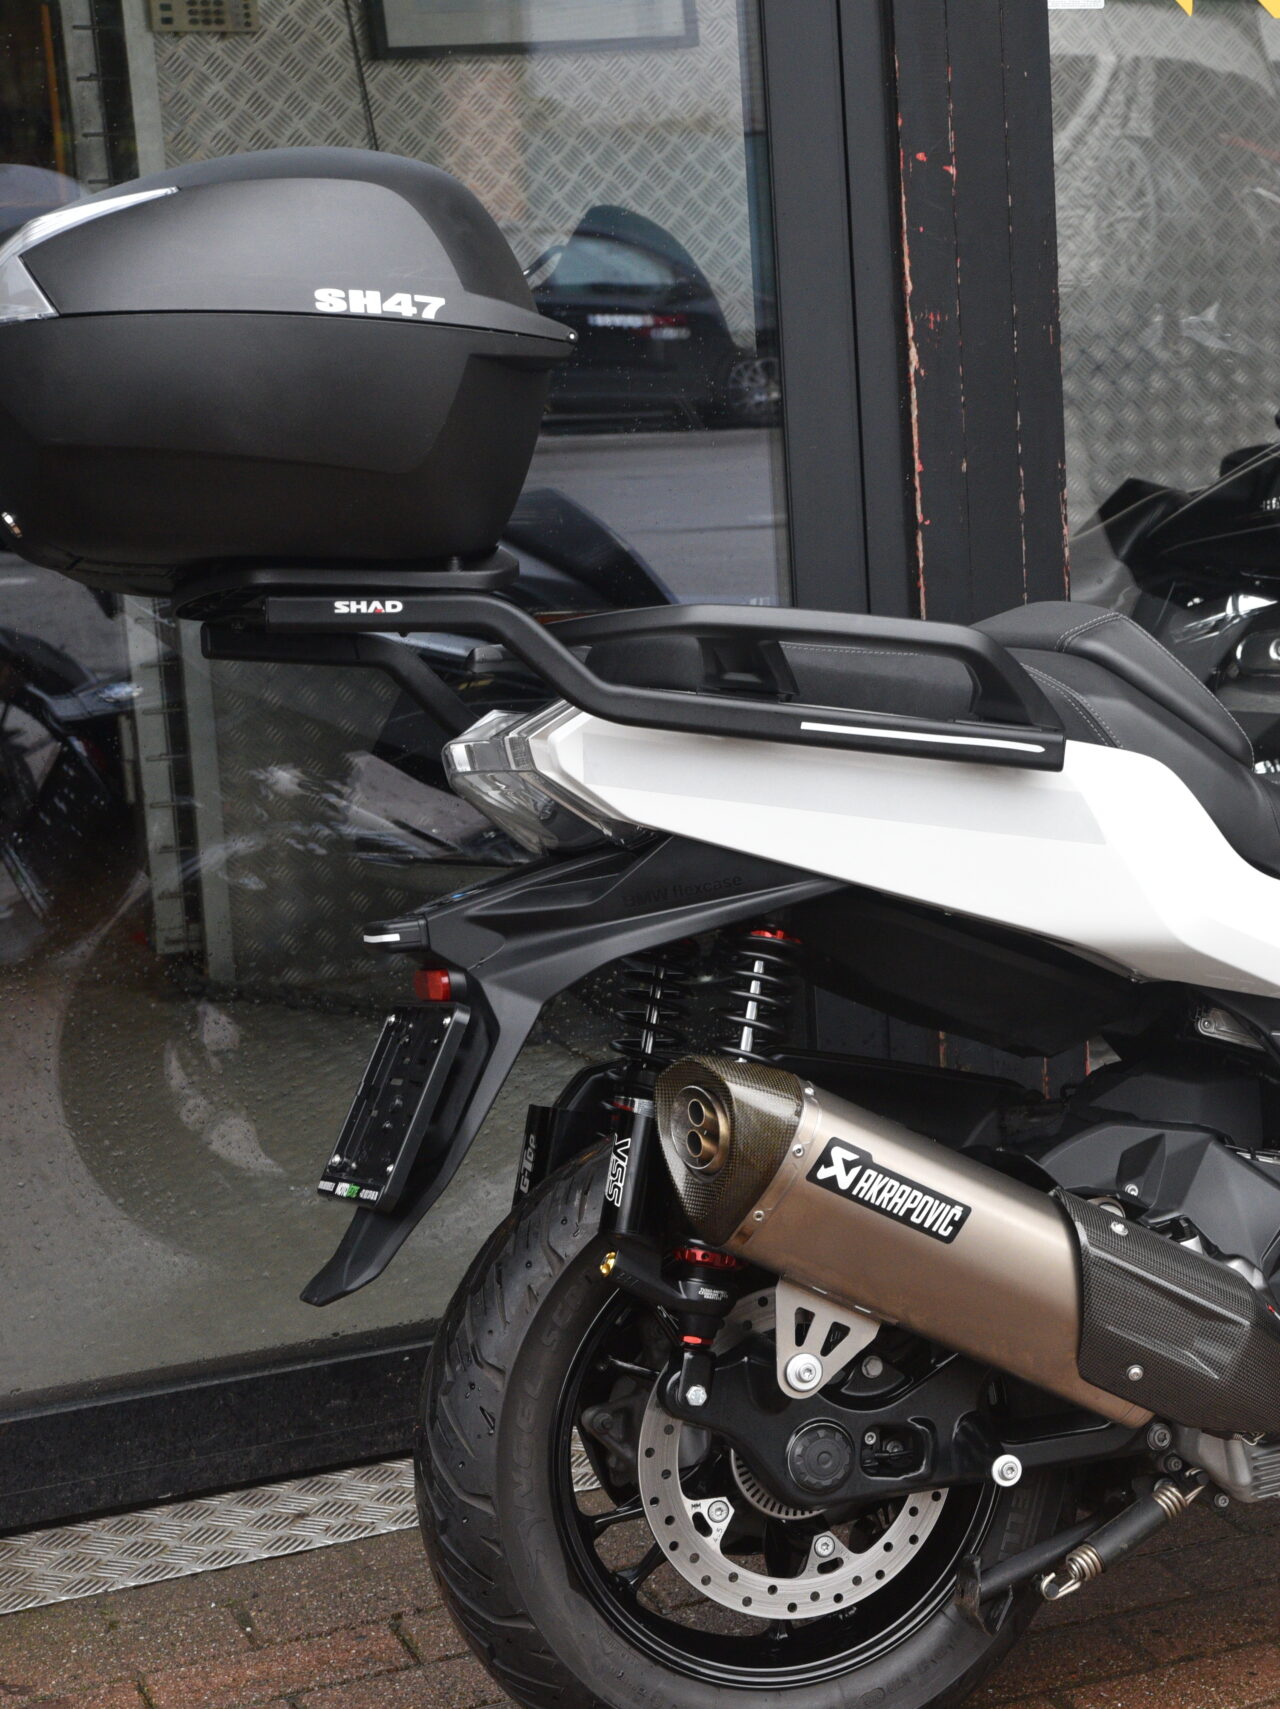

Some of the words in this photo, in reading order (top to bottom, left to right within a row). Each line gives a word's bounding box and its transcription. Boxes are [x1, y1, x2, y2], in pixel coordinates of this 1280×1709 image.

[314, 288, 446, 320] SH47
[333, 600, 404, 614] SHAD
[605, 1132, 632, 1207] YSS
